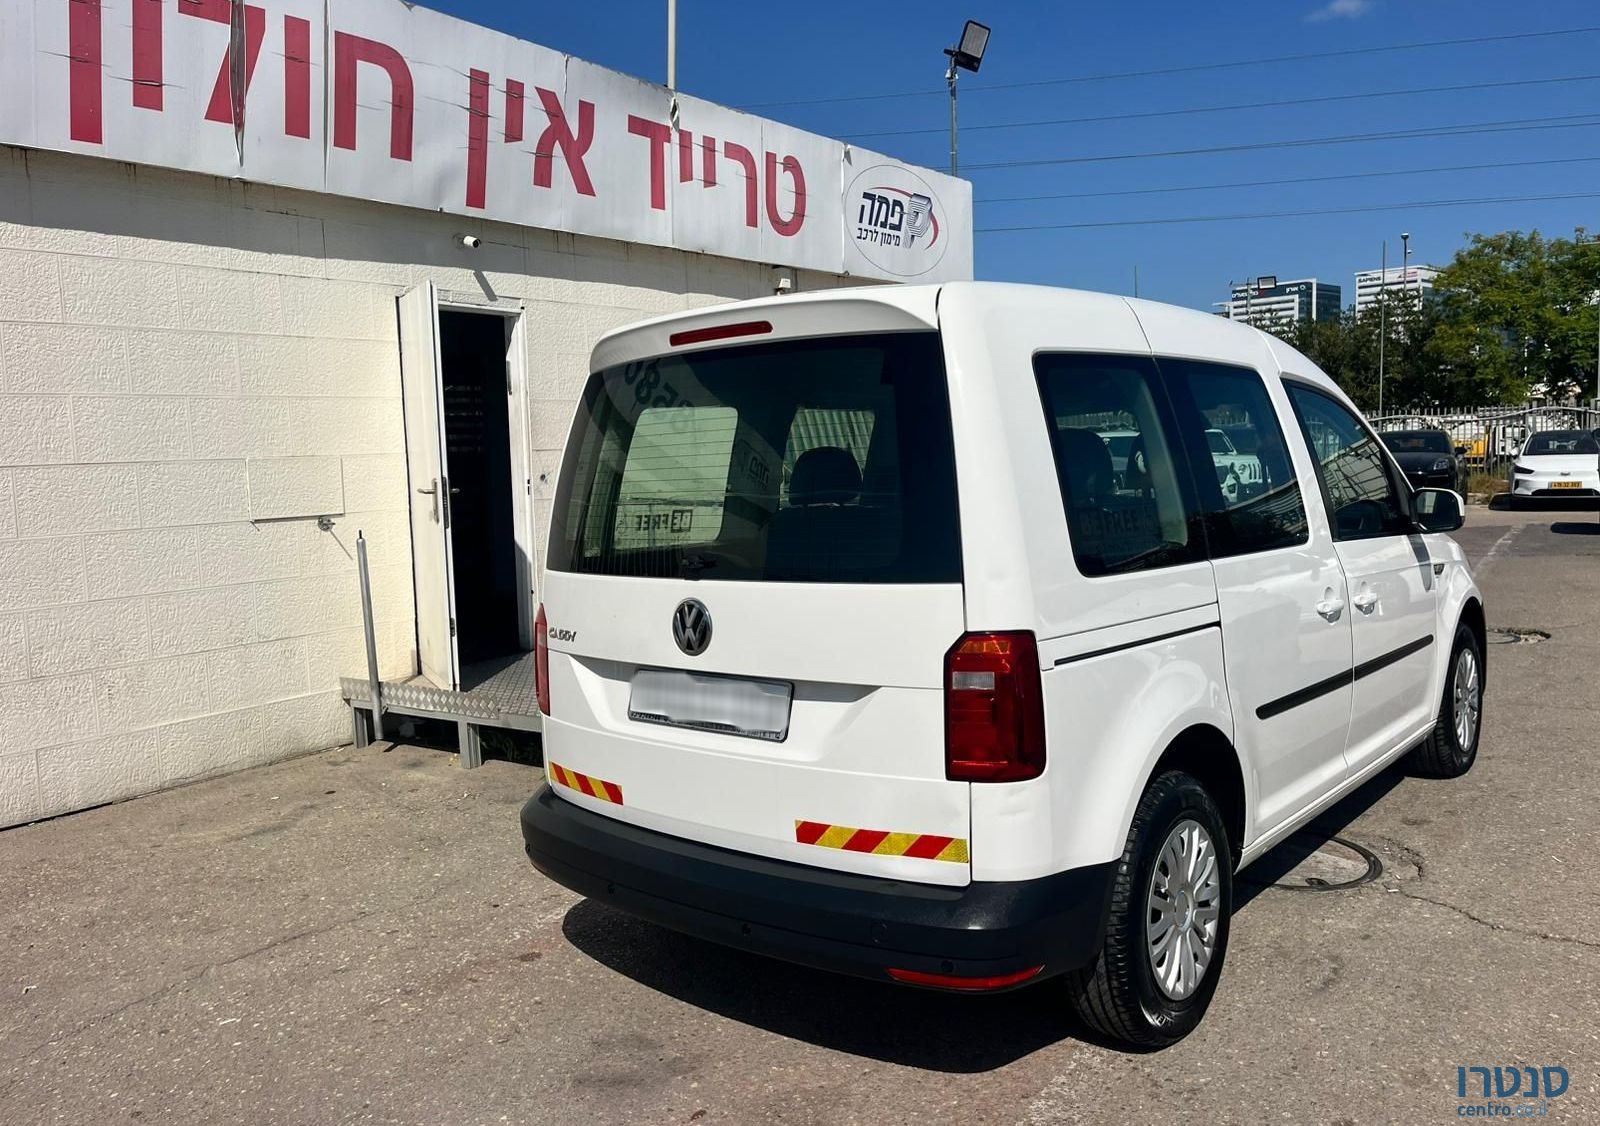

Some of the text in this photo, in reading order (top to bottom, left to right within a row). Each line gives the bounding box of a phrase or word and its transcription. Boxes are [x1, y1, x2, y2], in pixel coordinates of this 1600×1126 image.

[465, 68, 597, 209] אין
[627, 114, 807, 237] טרייד
[858, 191, 904, 232] פמה
[856, 227, 901, 246] מימון לרכב
[549, 627, 576, 642] CADDY
